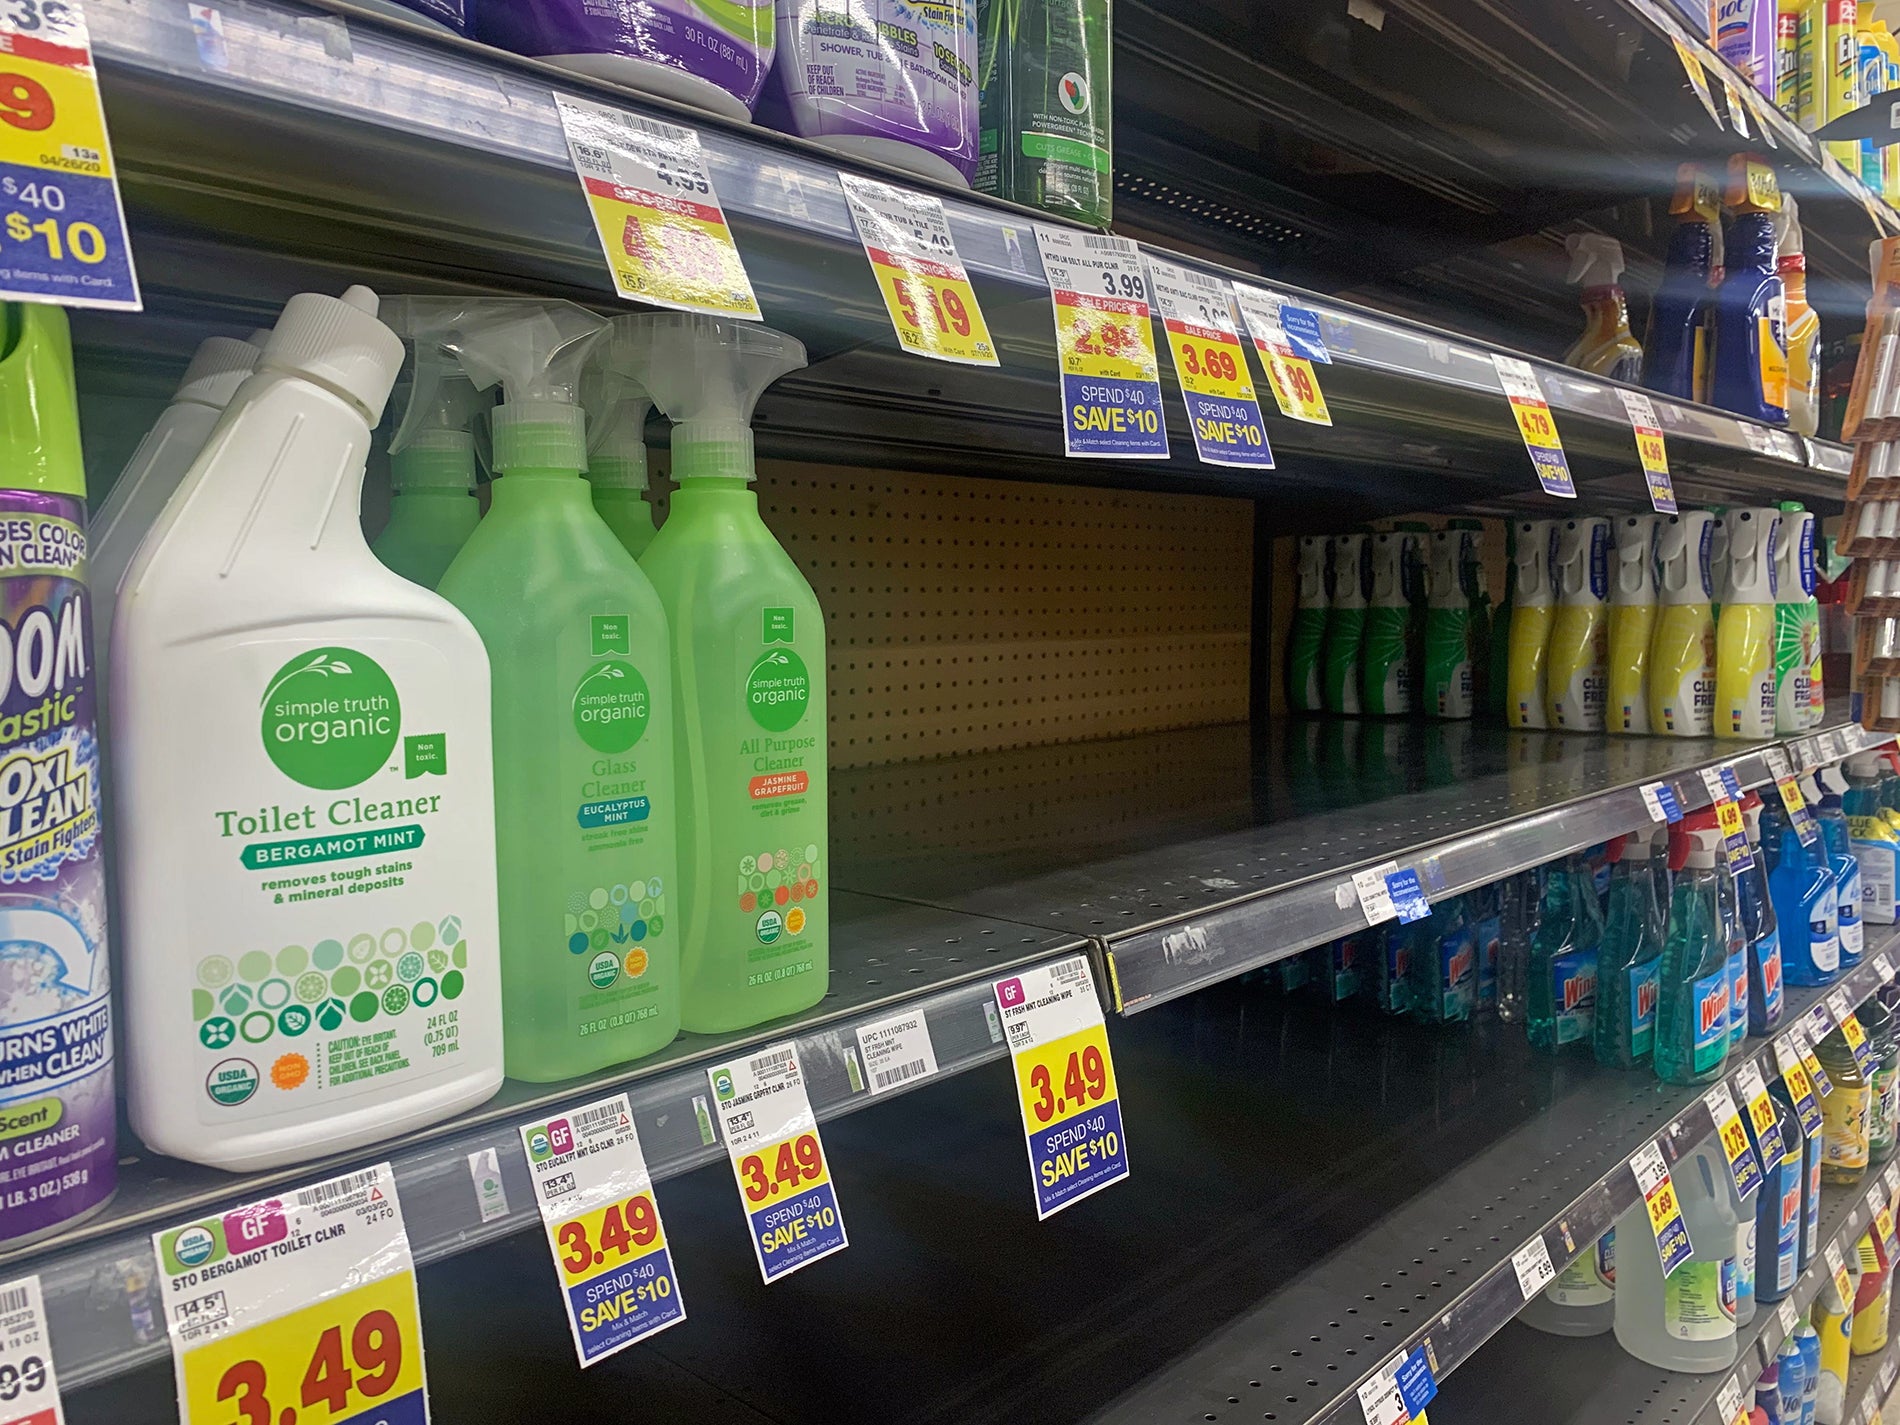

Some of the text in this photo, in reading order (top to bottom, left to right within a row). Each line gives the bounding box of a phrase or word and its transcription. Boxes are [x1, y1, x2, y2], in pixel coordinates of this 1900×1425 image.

[923, 6, 943, 19] Stain
[685, 26, 695, 42] 30
[697, 32, 706, 47] FL
[707, 36, 719, 53] OZ
[806, 64, 834, 75] KEEP OUT
[820, 42, 864, 58] SHOWER,
[909, 62, 947, 85] BATHROOM
[807, 74, 835, 84] OF REACH
[808, 85, 844, 96] OF CHILDREN
[72, 147, 99, 160] 13a
[1036, 144, 1055, 152] CUTS
[40, 154, 101, 173] 04/26/20
[1, 176, 66, 211] $40
[893, 214, 909, 224] TUB
[915, 220, 929, 230] TILE
[5, 211, 107, 264] $10
[1040, 233, 1049, 242] 11
[1102, 272, 1144, 299] 3.99
[1103, 301, 1127, 313] PRICE
[1184, 325, 1222, 341] SALE PRICE
[1182, 344, 1237, 381] 3.69
[1081, 385, 1144, 405] SPEND $40
[1073, 405, 1158, 433] SAVE $10
[1198, 401, 1248, 421] SPEND $40
[1196, 417, 1262, 446] SAVE $10
[1522, 411, 1549, 436] 4.79
[1643, 441, 1662, 461] 4.99
[1537, 462, 1568, 482] SAVE $10
[752, 676, 805, 689] simple truth
[275, 695, 389, 717] simple truth
[580, 691, 645, 706] simple truth
[752, 688, 806, 705] organic
[580, 704, 645, 724] organic
[275, 713, 390, 744] organic
[418, 743, 434, 751] Non
[740, 736, 815, 755] All Purpose
[416, 752, 438, 761] toxic.
[754, 756, 804, 772] Cleaner
[592, 760, 637, 777] Glass
[581, 778, 646, 799] Cleaner
[754, 782, 804, 796] GRAPEFRUIT
[763, 775, 797, 786] JASMINE
[215, 794, 441, 837] Toilet Cleaner
[584, 799, 645, 815] EUCALYPTUS
[604, 812, 628, 822] MINT
[1721, 807, 1738, 826] 4.99
[5, 812, 96, 868] Stain Fighters
[256, 830, 416, 863] BERGAMOT MINT
[262, 860, 413, 891] removes tough stains
[273, 876, 404, 904] & mineral deposits
[762, 918, 777, 927] USDA
[595, 959, 613, 970] USDA
[1004, 985, 1017, 1001] GF
[1036, 989, 1073, 1008] CLEANING WIPE
[62, 1008, 107, 1046] WHITE
[427, 1010, 458, 1029] 24 FL OZ
[424, 1025, 459, 1046] (0.75 QT)
[862, 1020, 918, 1044] UPC 1111087932
[432, 1040, 459, 1057] 709 mL
[866, 1047, 891, 1060] CLEANING
[218, 1069, 247, 1082] USDA
[1030, 1045, 1106, 1122] 3.49
[1788, 1070, 1808, 1100] 3.79
[214, 1081, 252, 1094] ORGANIC
[721, 1081, 785, 1111] STO JASMINE GRPFRT CLNR
[1753, 1099, 1772, 1134] 3.79
[14, 1124, 80, 1156] CLEANER
[551, 1126, 569, 1147] GF
[1046, 1115, 1105, 1153] SPEND $40
[1724, 1123, 1745, 1159] 3.79
[536, 1138, 615, 1173] STO EUCALYPT MNT GLS CLNR
[1041, 1131, 1118, 1187] SAVE $10
[741, 1134, 823, 1202] 3.49
[7, 1191, 28, 1208] LB.
[29, 1187, 37, 1201] 3
[1652, 1191, 1672, 1221] 3.69
[365, 1207, 394, 1226] 24 FO
[765, 1195, 821, 1228] SPEND $40
[241, 1217, 270, 1242] GF
[558, 1195, 658, 1275] 3.49
[761, 1206, 834, 1253] SAVE $10
[182, 1235, 205, 1248] USDA
[1661, 1240, 1678, 1262] SAVE
[172, 1223, 346, 1291] STO BERGAMOT TOILET CLNR
[1538, 1261, 1552, 1279] 6.99
[586, 1263, 655, 1302] SPEND $40
[580, 1275, 671, 1332] SAVE $10
[605, 1328, 632, 1346] Cleaning
[217, 1309, 402, 1425] 3.49
